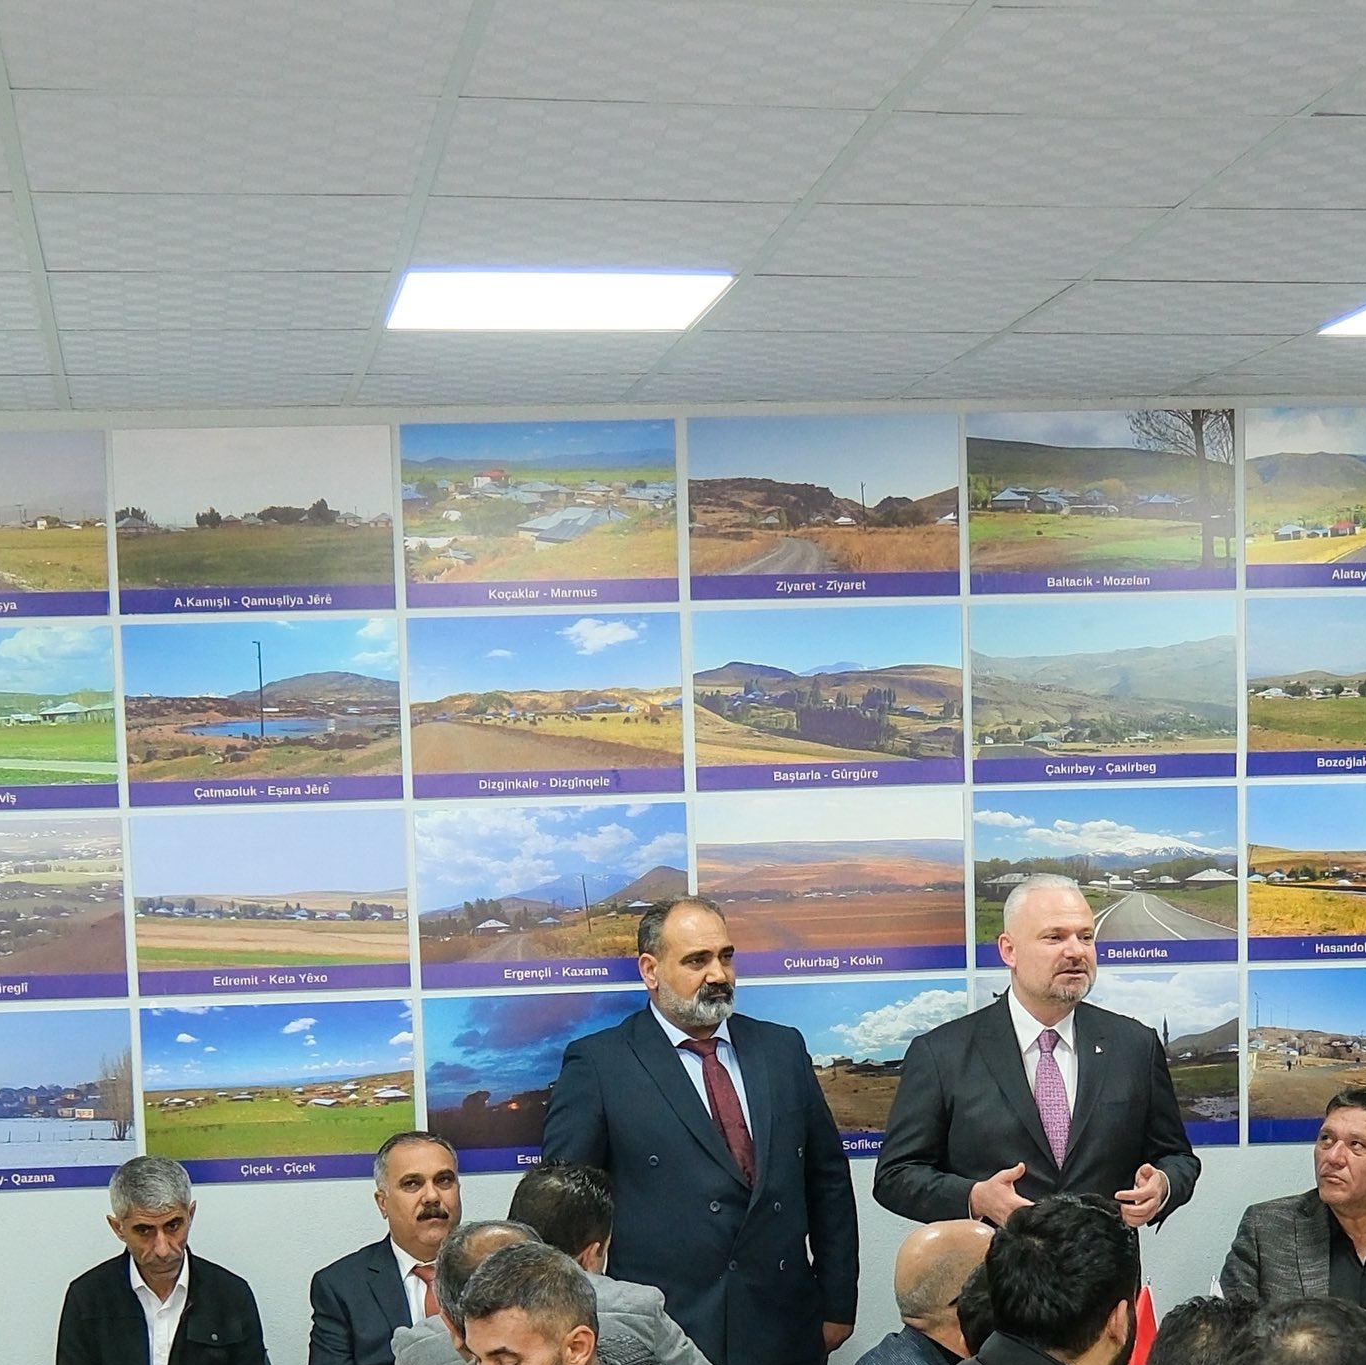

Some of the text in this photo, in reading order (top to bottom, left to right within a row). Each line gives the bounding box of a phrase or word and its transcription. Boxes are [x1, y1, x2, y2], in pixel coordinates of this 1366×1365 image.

[1048, 576, 1092, 586] Baltacık
[1104, 576, 1150, 585] Mozelan
[1332, 569, 1366, 581] Alatay
[776, 582, 815, 593] Ziyaret
[489, 588, 539, 600] Koçaklar
[551, 588, 597, 597] Marmus
[174, 597, 230, 608] A.Kamışlı
[307, 594, 331, 604] Jêrê
[1046, 763, 1095, 776] Çakırbey
[774, 770, 821, 782] Baştarla
[479, 778, 538, 791] Dizginkale
[194, 786, 257, 800] Çatmaoluk
[268, 786, 301, 797] Eşara
[305, 783, 329, 794] Jêrê
[784, 957, 839, 970] Çukurbağ
[850, 955, 882, 965] Kokin
[504, 967, 551, 980] Ergençli
[562, 967, 608, 976] Kaxama
[214, 975, 258, 986] Edremit
[270, 975, 295, 984] Keta
[241, 1164, 273, 1176] Çiçek
[284, 1163, 315, 1175] Çîçek
[11, 1174, 55, 1185] Qazana
